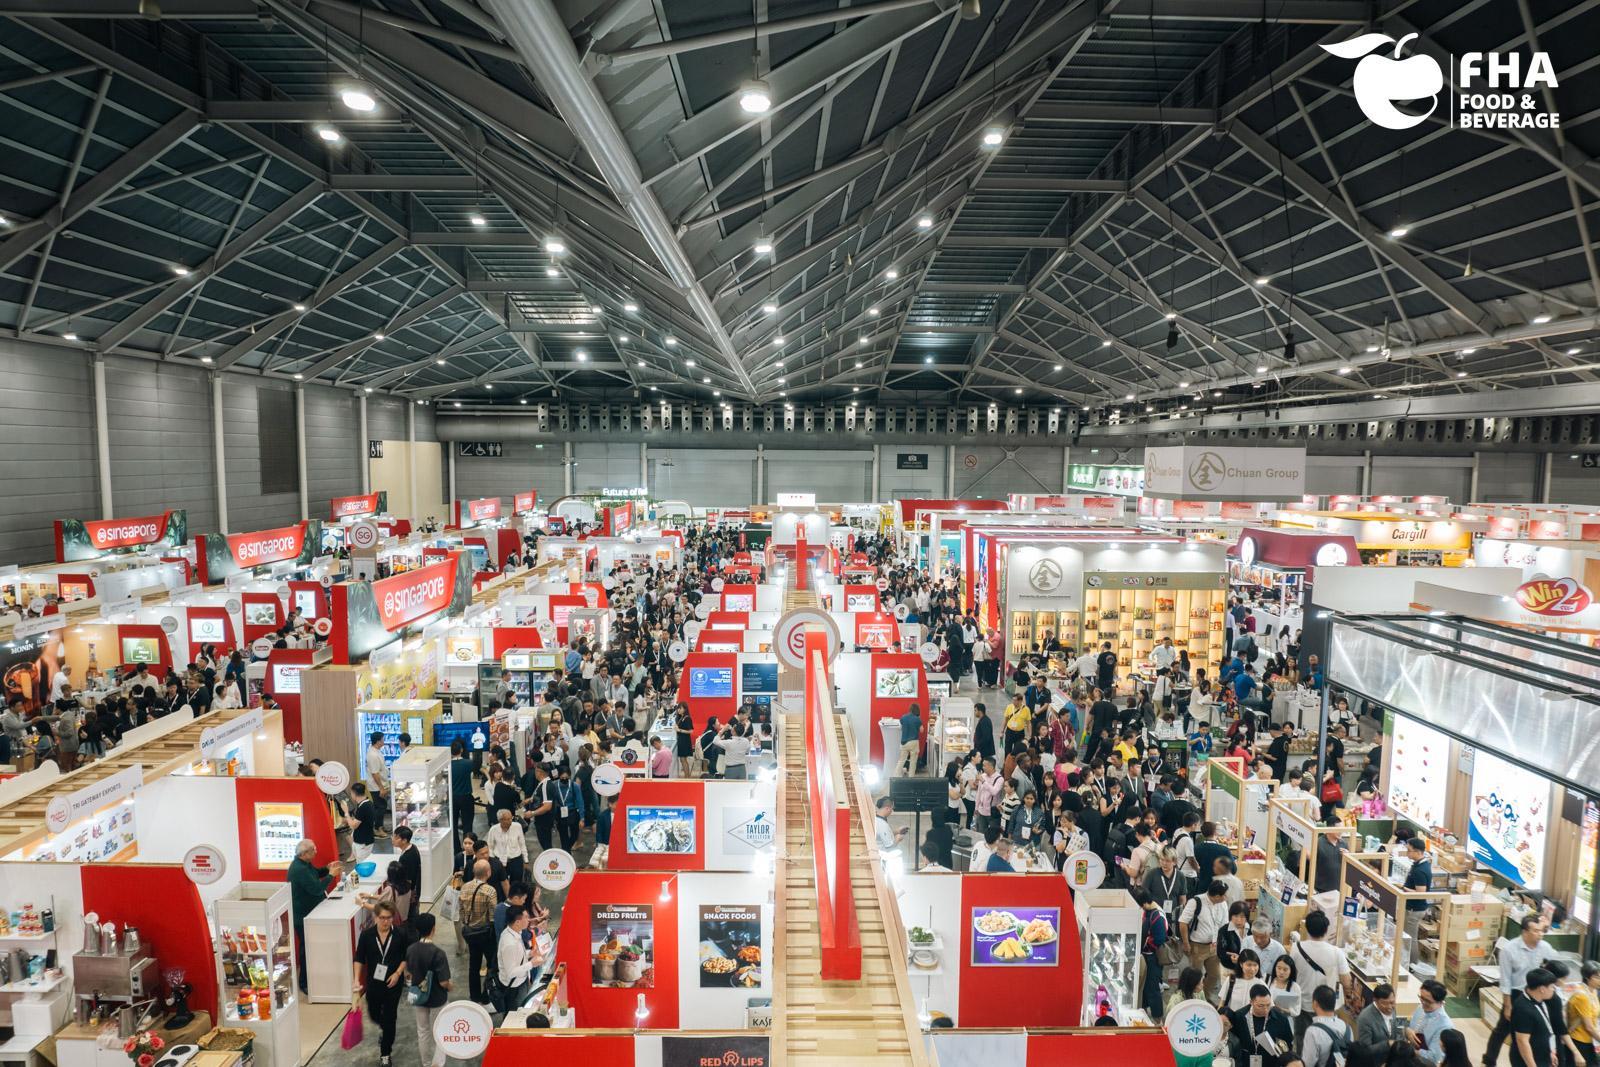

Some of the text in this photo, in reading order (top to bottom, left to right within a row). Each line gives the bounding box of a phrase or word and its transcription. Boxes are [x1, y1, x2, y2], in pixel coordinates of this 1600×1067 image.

[1227, 467, 1262, 478] Chuan
[1266, 468, 1299, 480] Group
[603, 488, 629, 496] Future
[1392, 529, 1427, 541] Cargill
[81, 792, 101, 807] GATEWAY
[102, 782, 122, 797] EXPORTS
[746, 824, 770, 834] TAYLOR
[700, 1057, 764, 1067] RED LIPS
